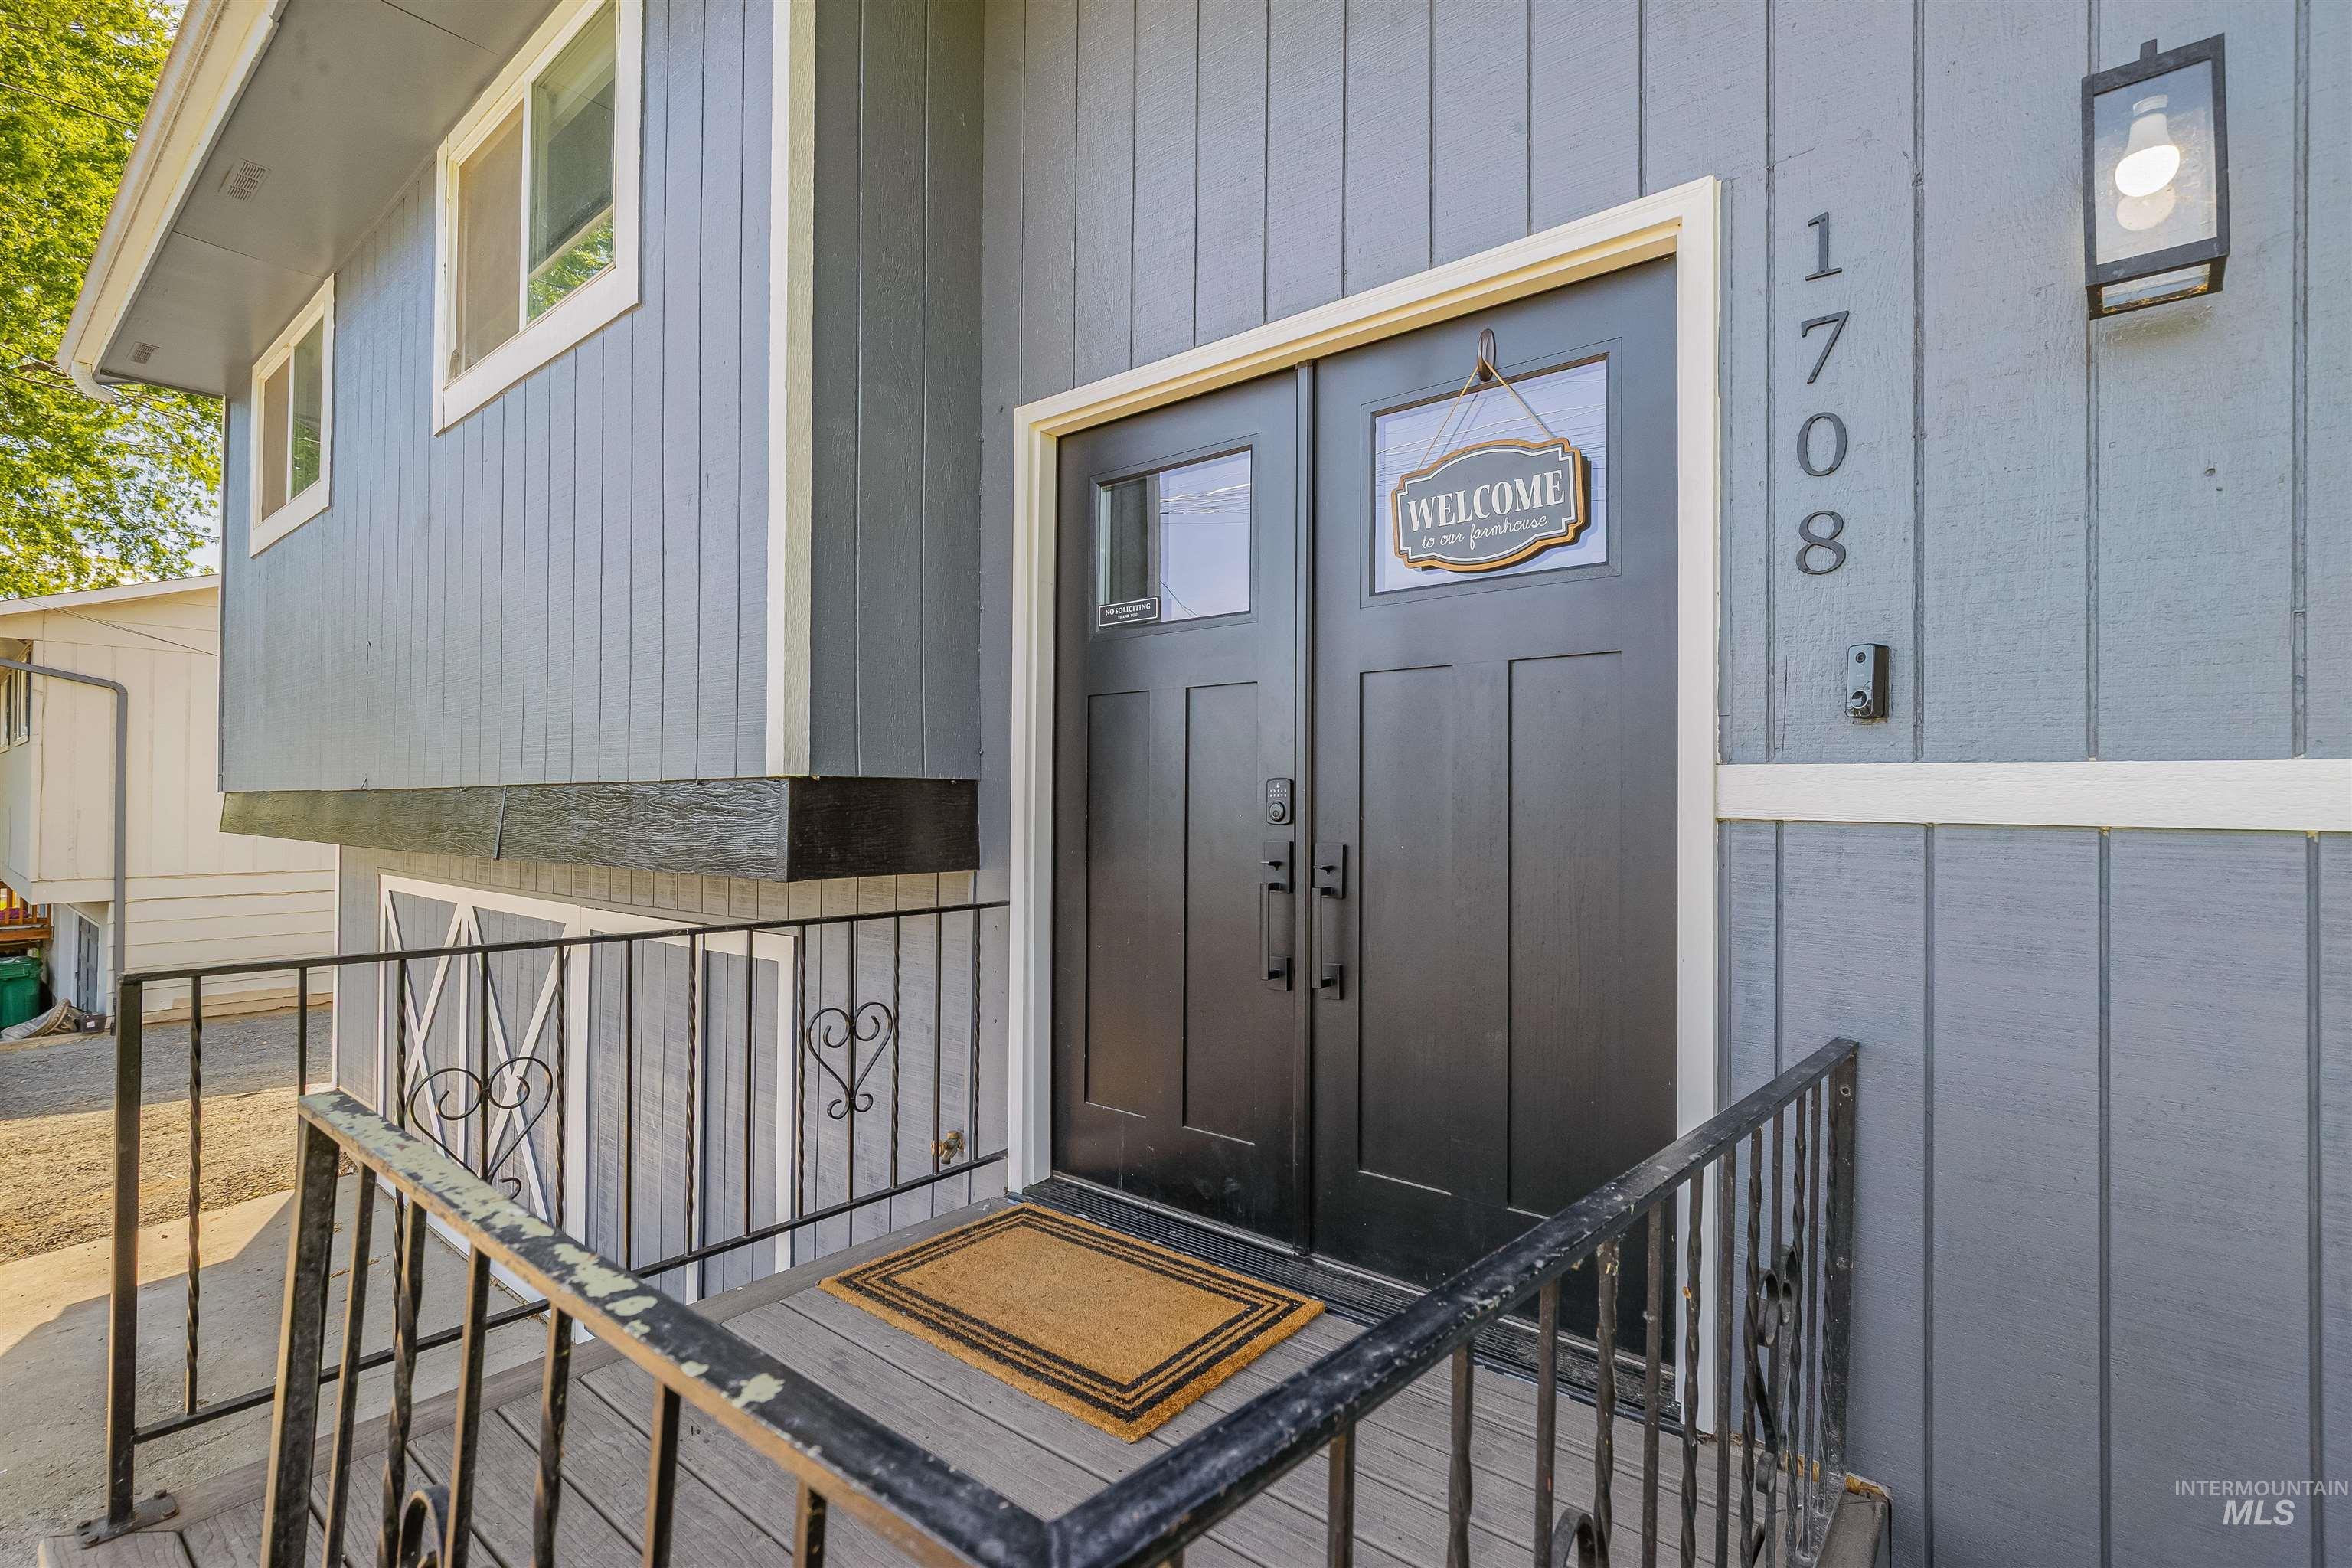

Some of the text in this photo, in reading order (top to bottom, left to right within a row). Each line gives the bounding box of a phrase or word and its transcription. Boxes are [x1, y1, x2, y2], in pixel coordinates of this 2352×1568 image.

[1796, 211, 1849, 575] 1708
[1407, 469, 1565, 531] WELCOME
[1421, 515, 1549, 550] to our farmhouse
[1115, 603, 1151, 614] SOLICITING
